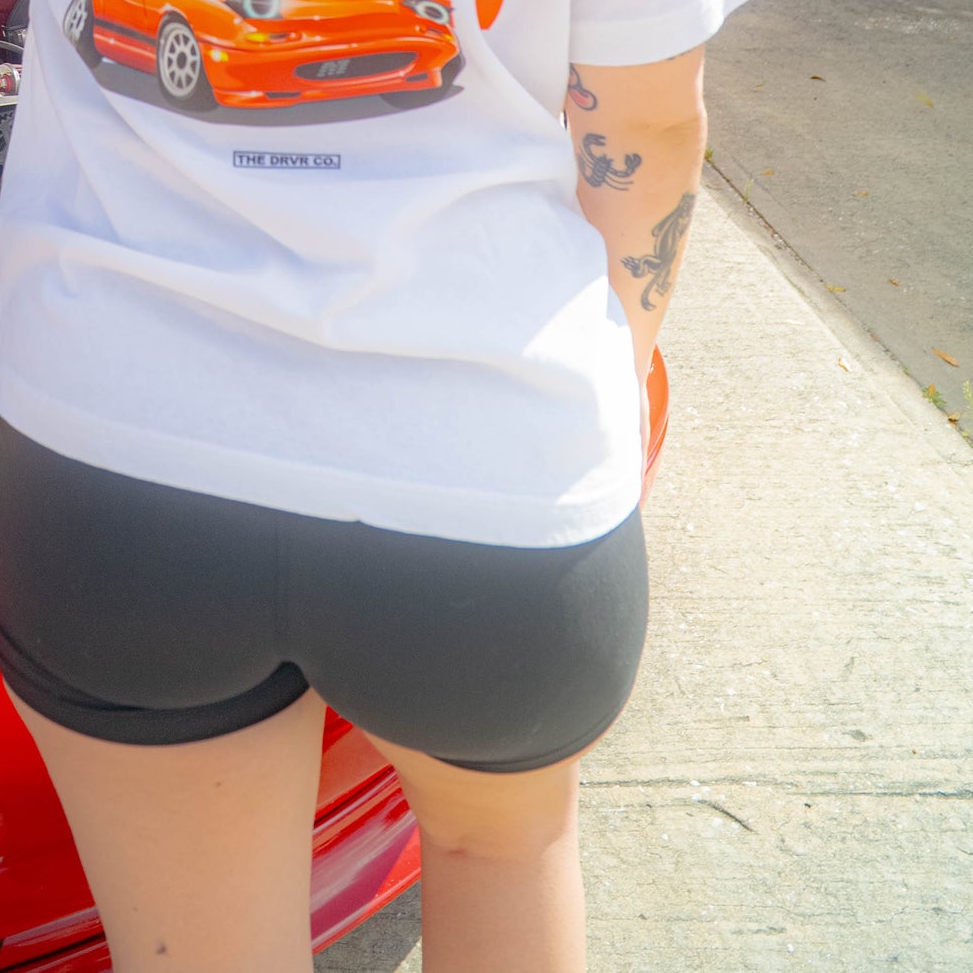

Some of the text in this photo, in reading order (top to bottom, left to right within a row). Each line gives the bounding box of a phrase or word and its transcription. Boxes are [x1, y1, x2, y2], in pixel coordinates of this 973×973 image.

[238, 155, 336, 166] THE DRVR CO.
